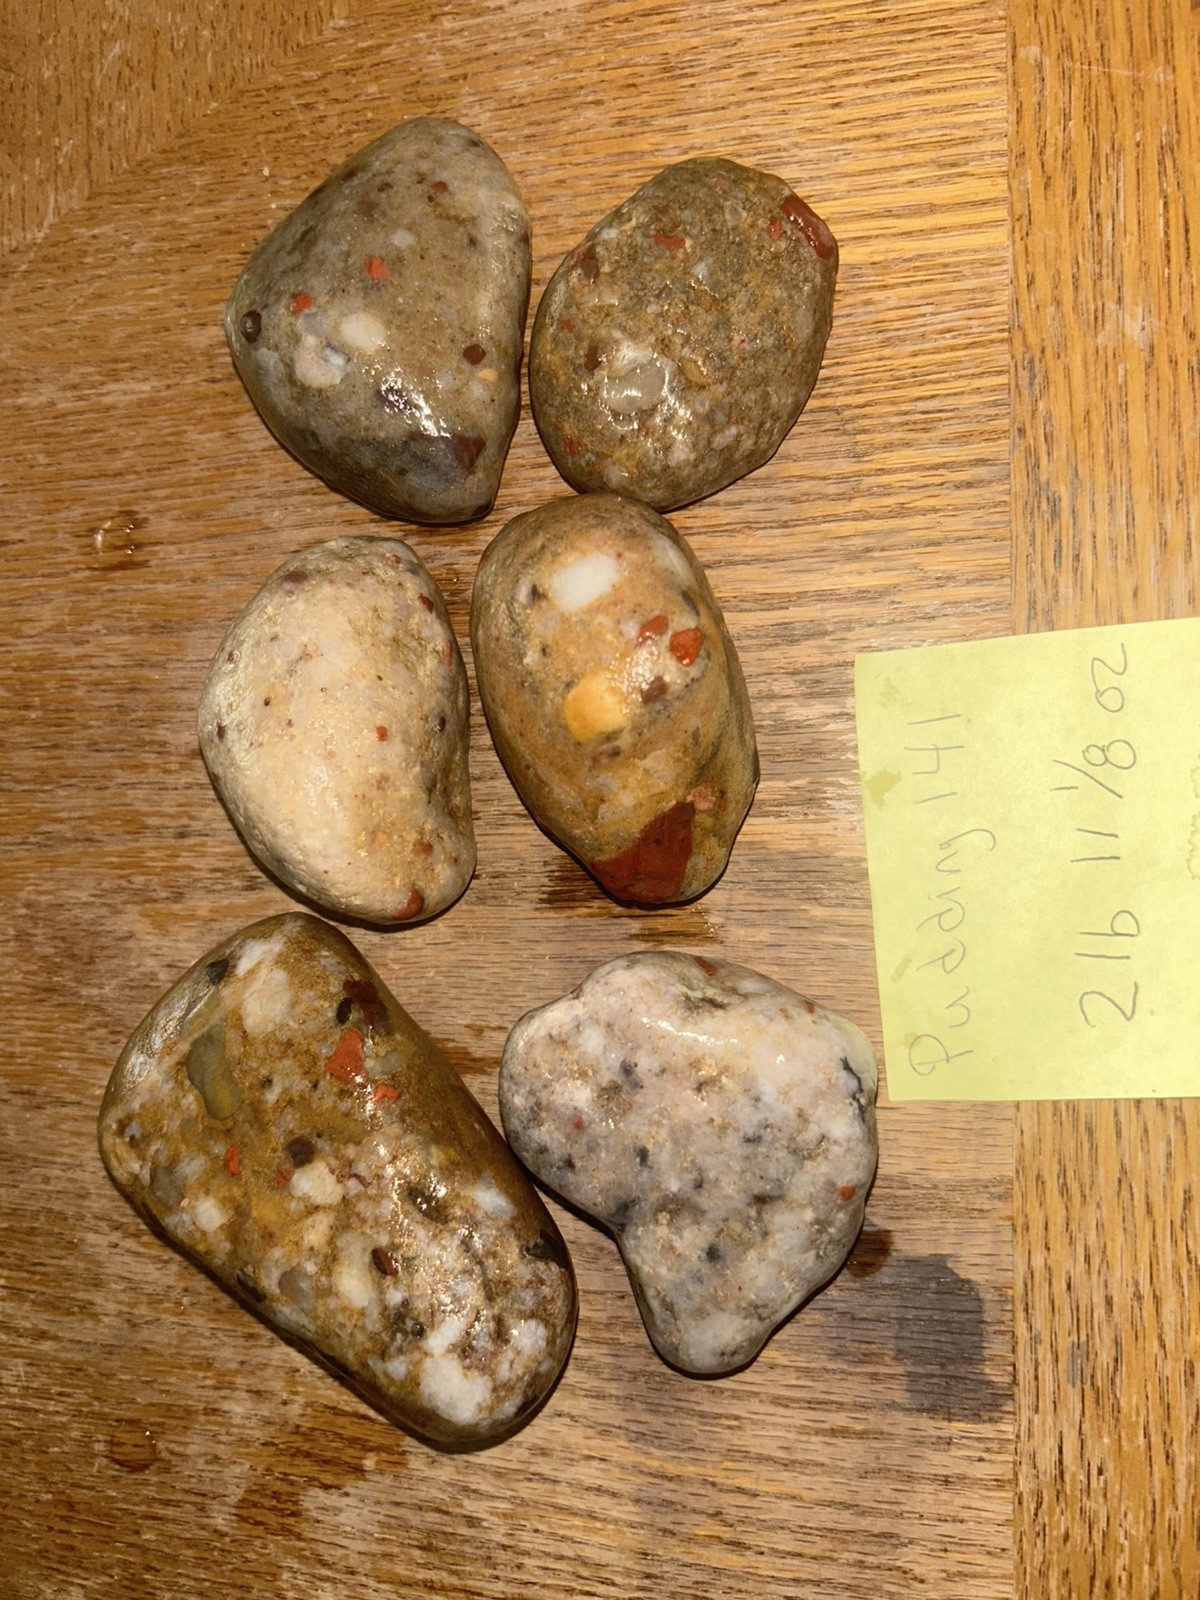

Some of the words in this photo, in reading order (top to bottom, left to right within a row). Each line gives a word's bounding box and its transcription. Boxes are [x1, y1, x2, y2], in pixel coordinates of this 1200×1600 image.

[1091, 643, 1128, 713] oz
[904, 714, 965, 804] 141
[908, 828, 996, 1076] Pudding
